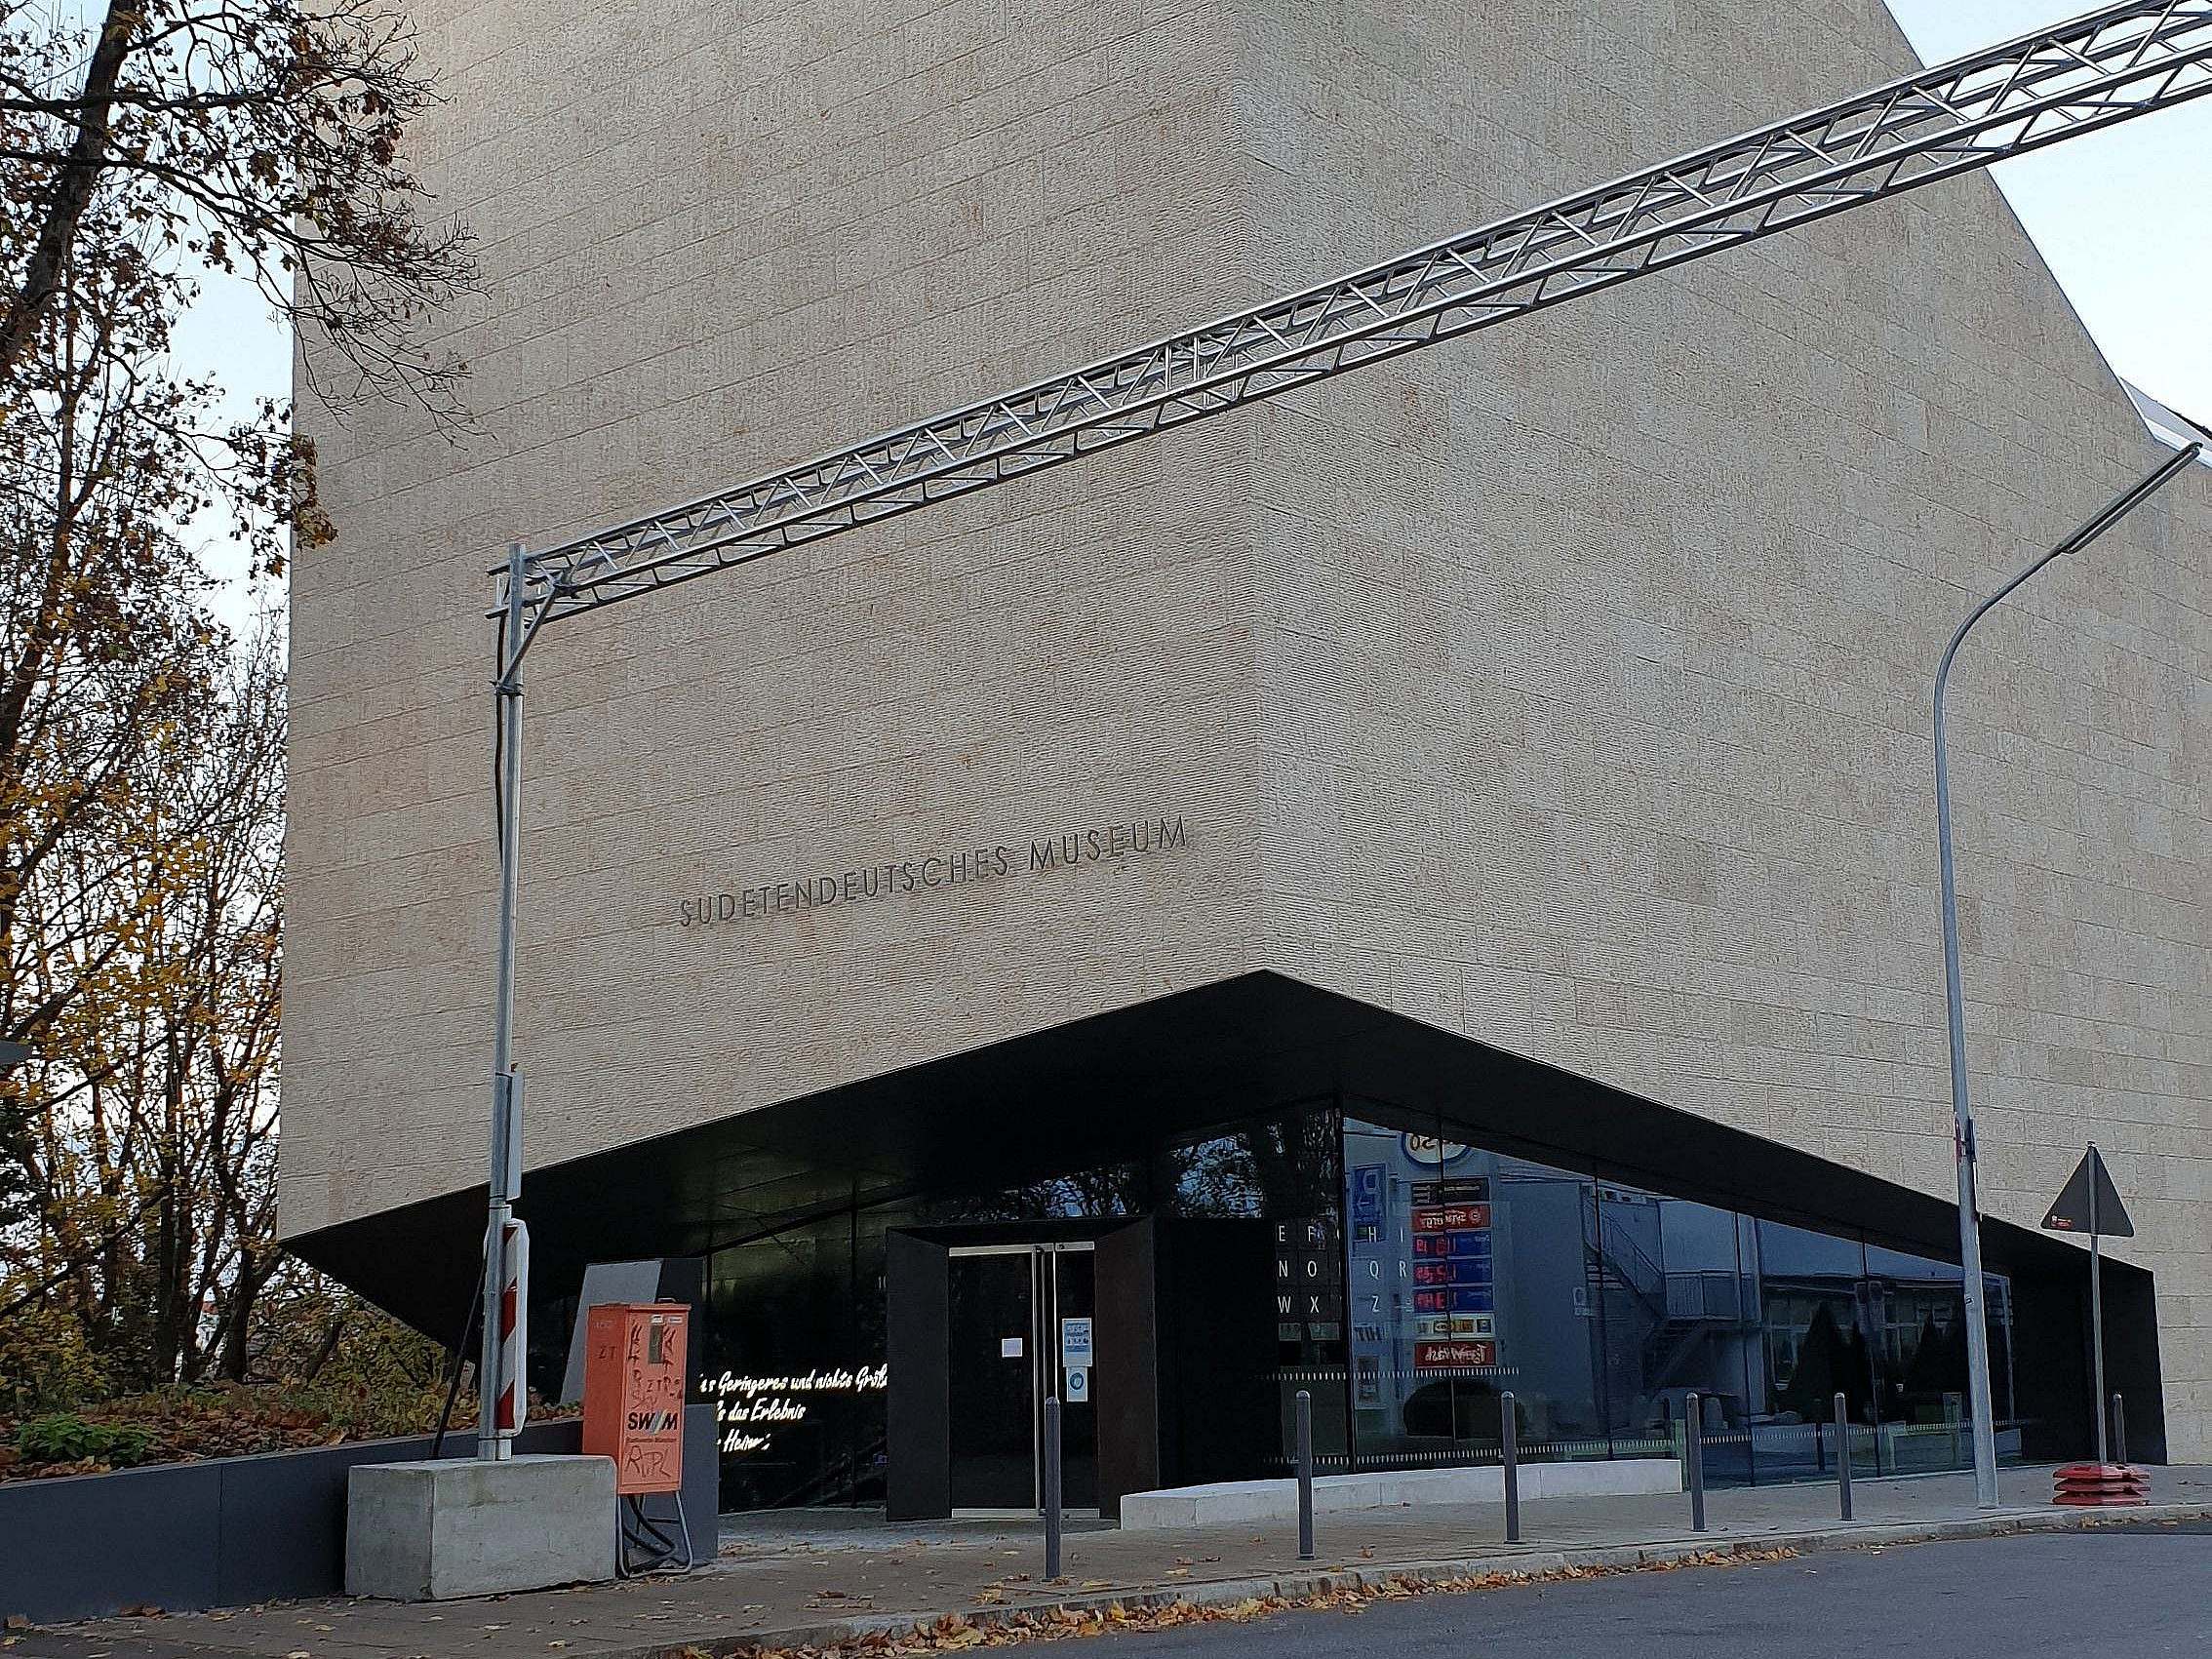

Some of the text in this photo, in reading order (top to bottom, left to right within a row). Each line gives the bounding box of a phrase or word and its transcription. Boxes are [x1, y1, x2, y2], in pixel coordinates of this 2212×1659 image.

[679, 814, 1188, 928] SUDETENDEUTSCHES MUSEUM
[1278, 1225, 1286, 1243] E
[1308, 1226, 1315, 1243] F
[1368, 1226, 1377, 1244] H
[1279, 1260, 1288, 1278] N
[1307, 1260, 1318, 1278] O
[1369, 1260, 1379, 1281] Q
[1399, 1260, 1406, 1278] R
[1277, 1295, 1380, 1314] W X Z
[718, 1370, 788, 1399] Geringeres
[790, 1368, 815, 1391] und
[728, 1401, 750, 1422] das
[750, 1398, 807, 1422] Erlebnis
